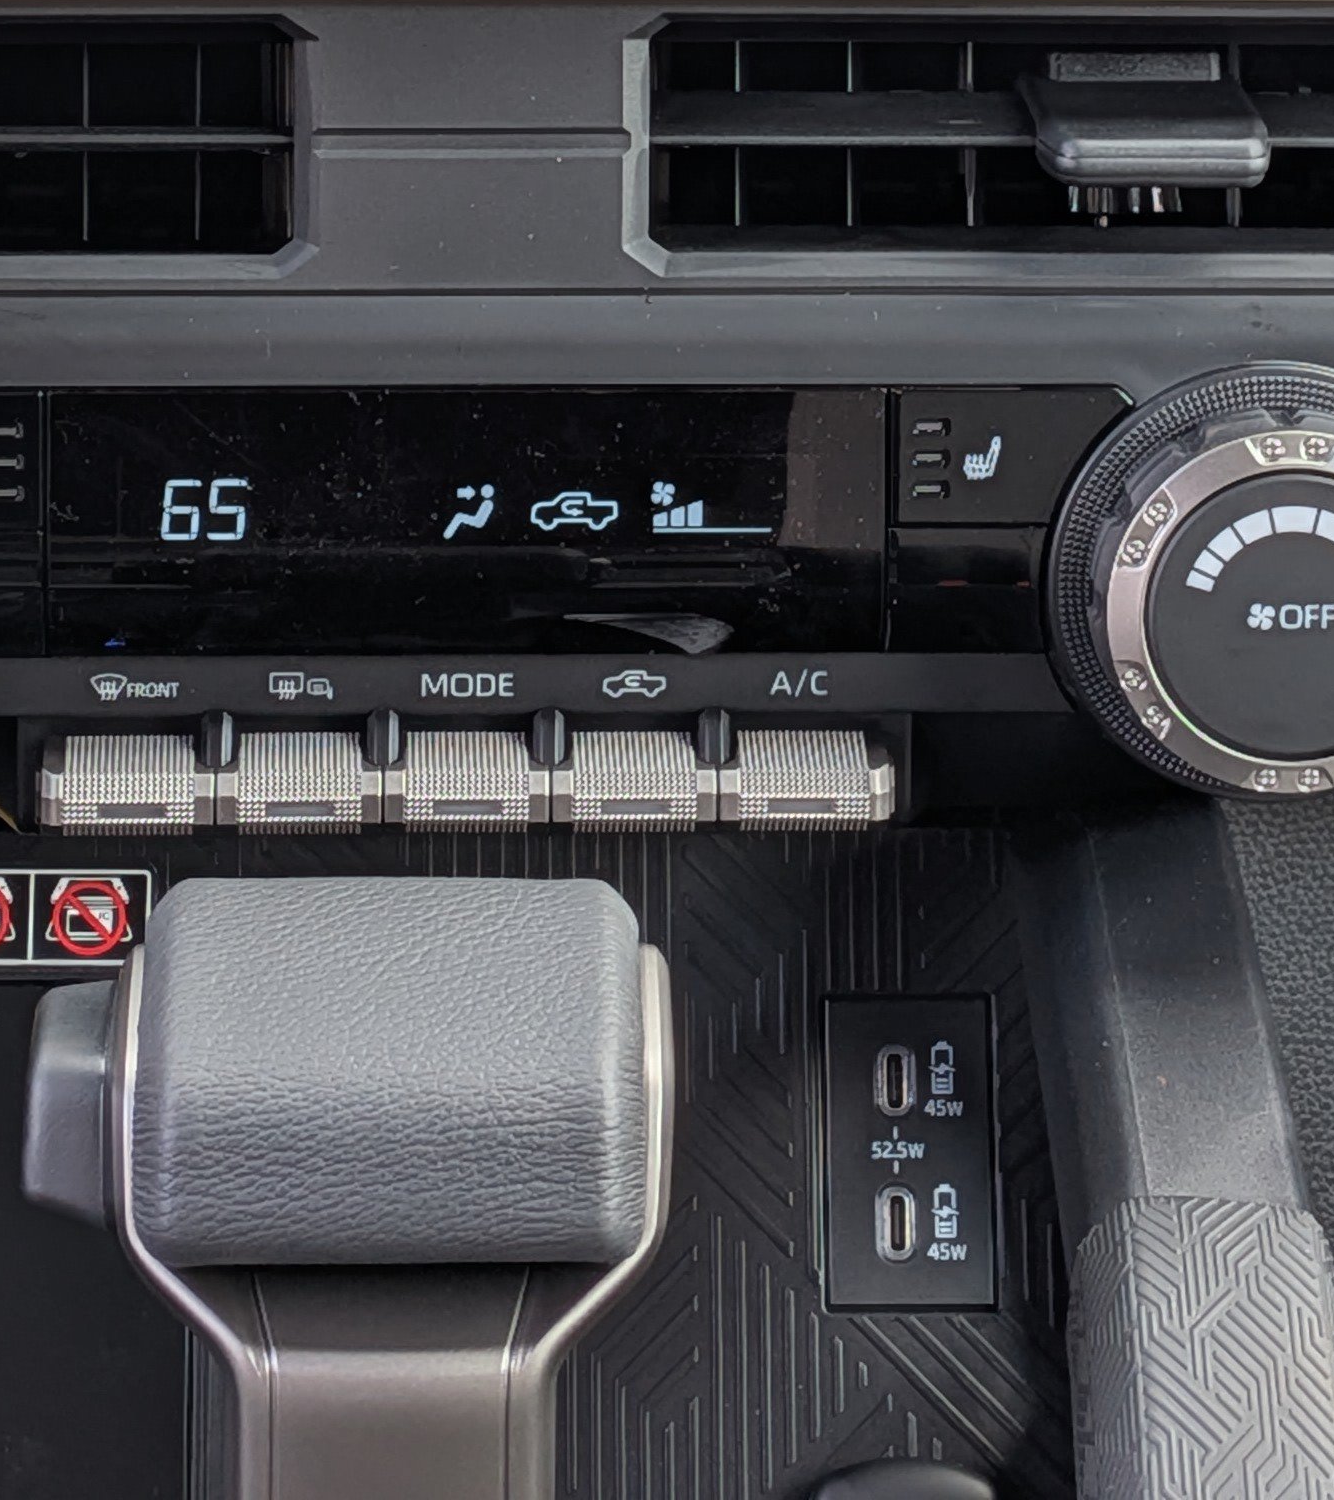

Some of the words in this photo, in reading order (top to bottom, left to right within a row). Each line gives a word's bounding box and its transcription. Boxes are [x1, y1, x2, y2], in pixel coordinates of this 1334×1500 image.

[160, 478, 248, 541] 65
[126, 681, 180, 699] FRONT
[420, 672, 515, 699] MODE
[769, 669, 829, 698] A/C
[924, 1099, 964, 1118] 45W
[927, 1242, 968, 1262] 45W
